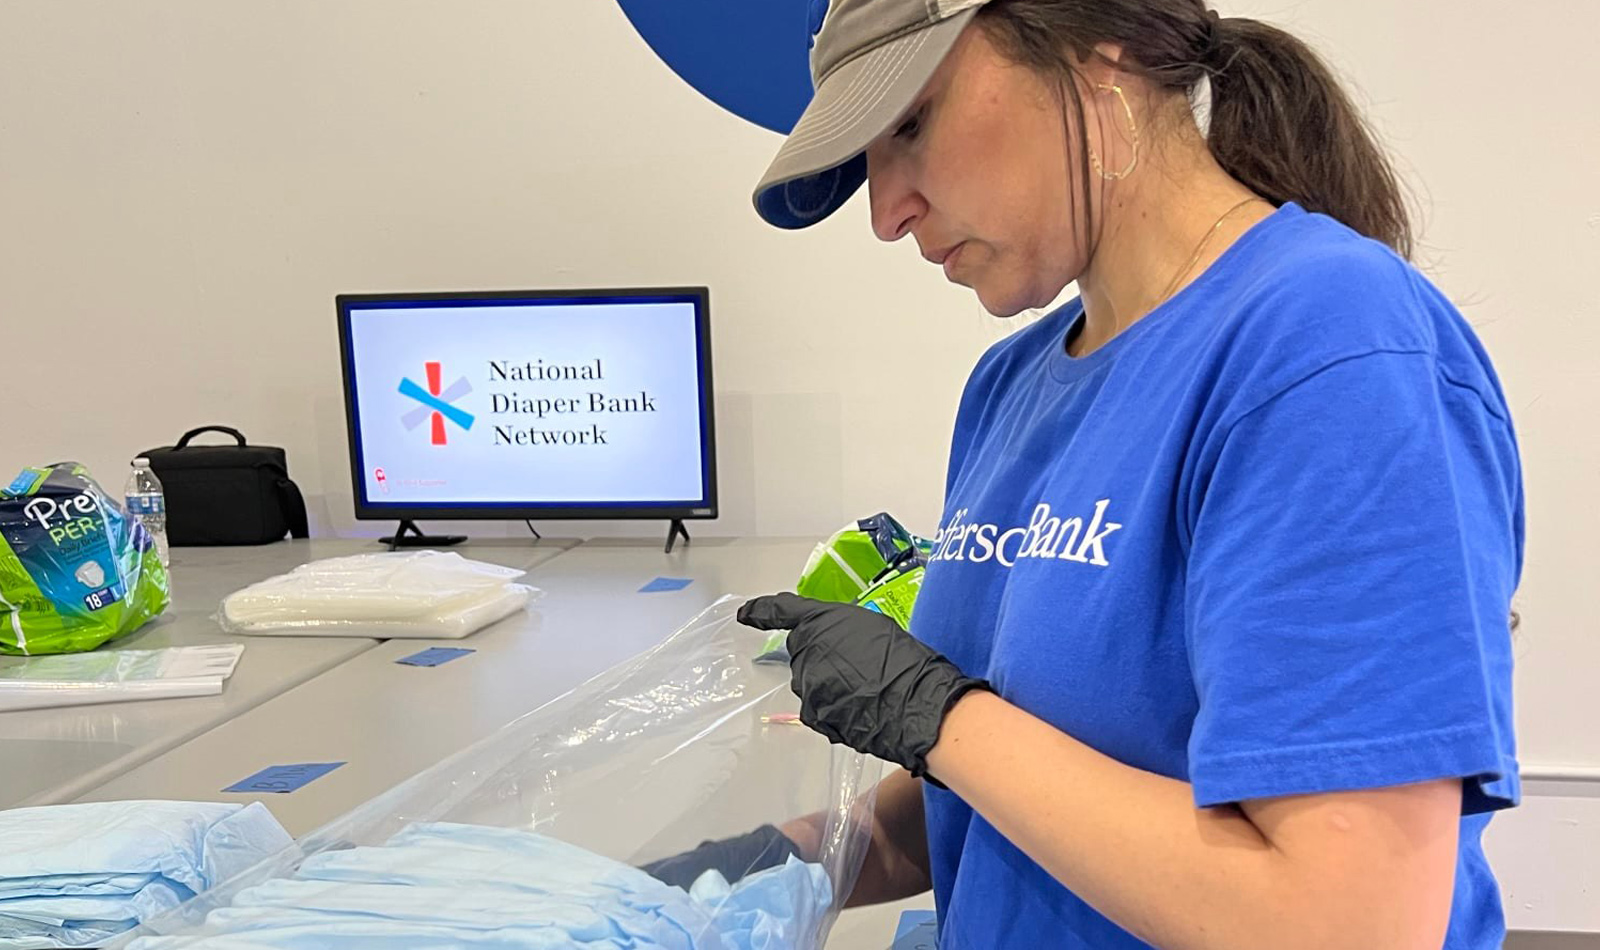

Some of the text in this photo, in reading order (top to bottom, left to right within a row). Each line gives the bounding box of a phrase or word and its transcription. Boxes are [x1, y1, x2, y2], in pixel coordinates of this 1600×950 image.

[488, 358, 604, 382] National
[490, 391, 657, 419] Diaper Bank
[492, 424, 609, 446] Network
[1017, 499, 1122, 566] Bank
[85, 593, 103, 610] 18
